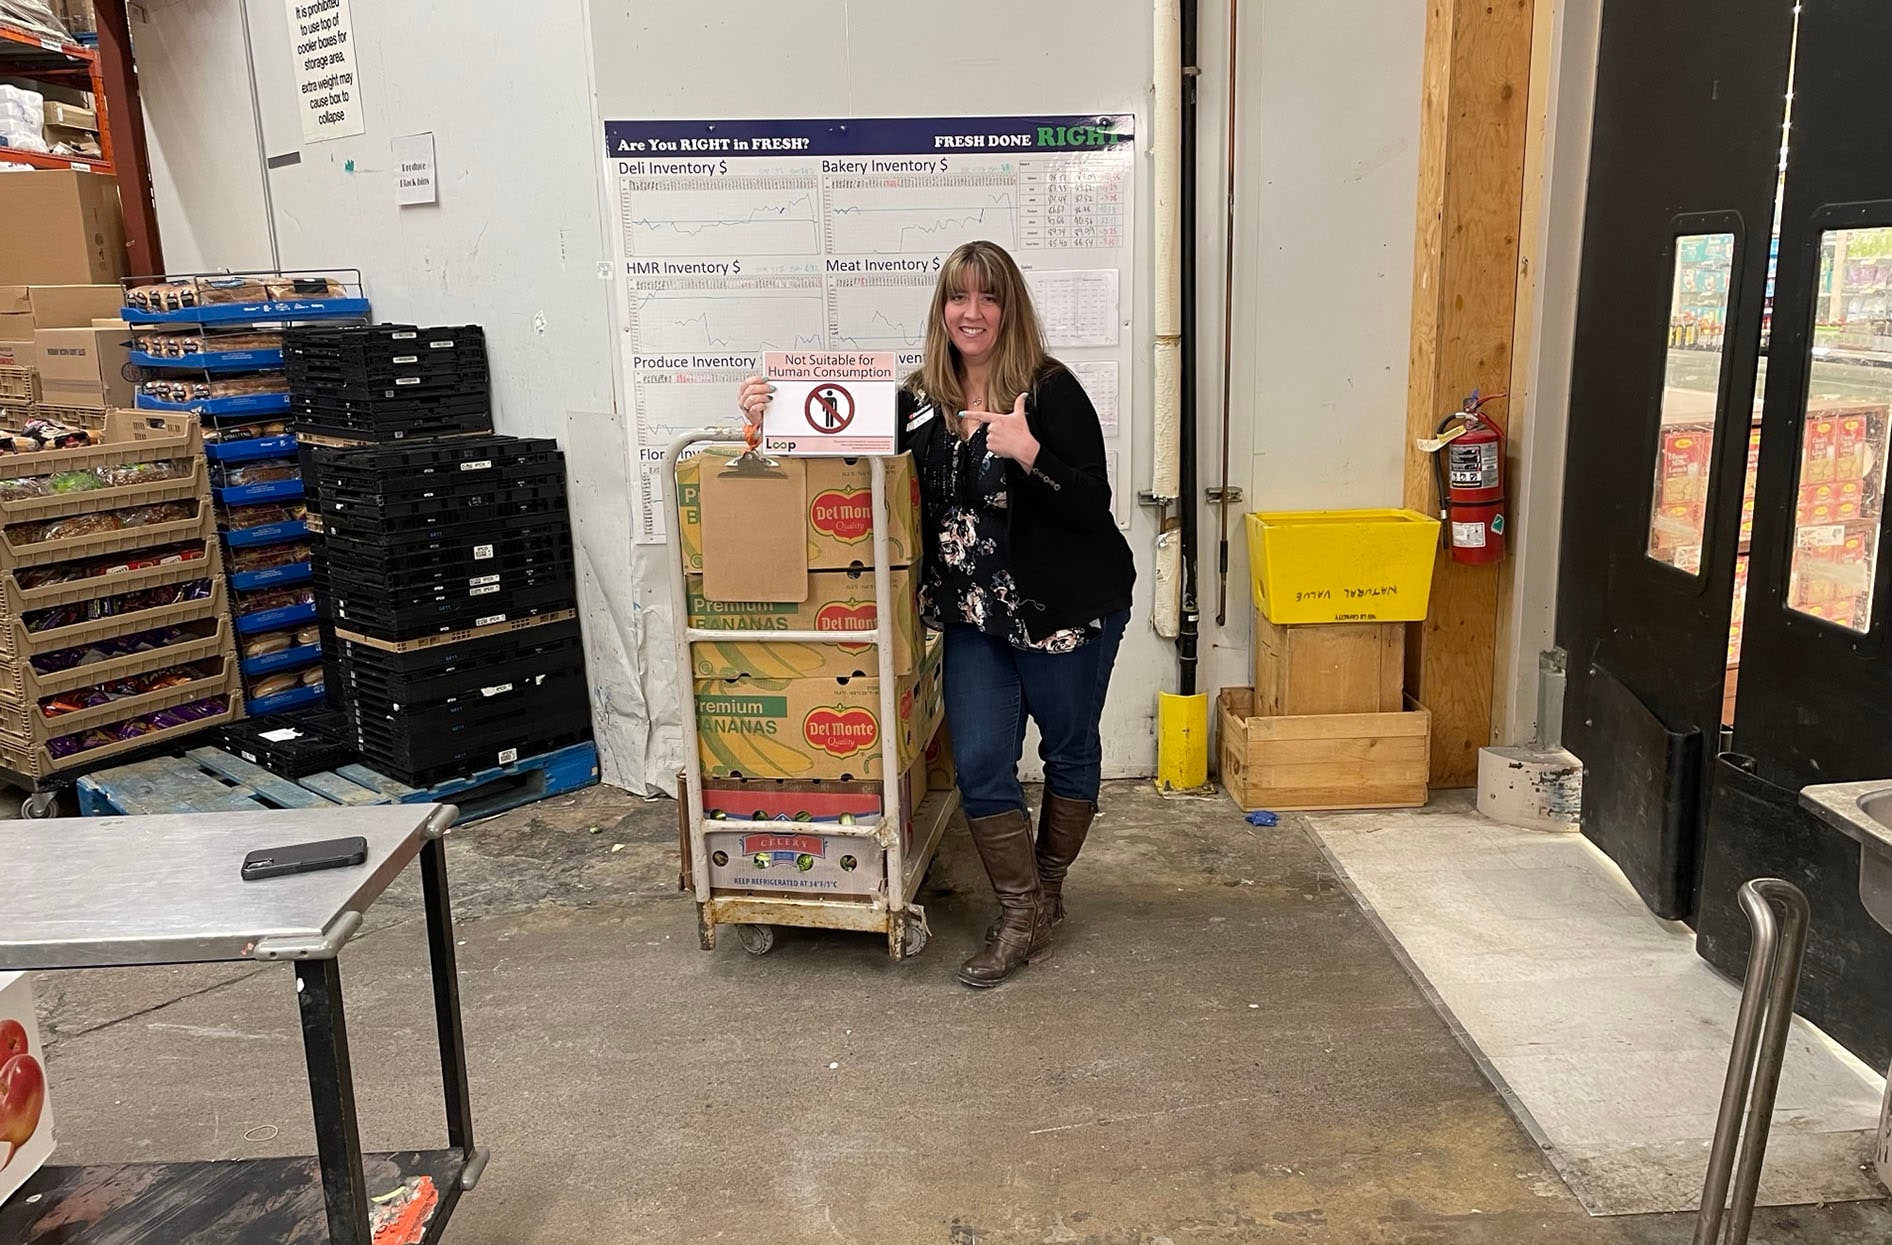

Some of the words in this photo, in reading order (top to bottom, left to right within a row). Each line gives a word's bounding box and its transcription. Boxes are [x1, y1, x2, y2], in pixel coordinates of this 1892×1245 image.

[295, 6, 301, 20] It
[301, 5, 308, 18] is
[308, 0, 340, 19] prohibited
[300, 24, 308, 36] to
[308, 21, 320, 34] use
[320, 18, 332, 31] top
[333, 12, 340, 26] of
[297, 39, 317, 55] cooler
[318, 34, 338, 50] boxes
[338, 30, 347, 43] for
[304, 55, 329, 71] storage
[301, 80, 317, 94] extra
[318, 73, 339, 90] weight
[339, 72, 353, 86] may
[309, 96, 329, 109] cause
[328, 92, 341, 106] box
[341, 90, 350, 103] to
[318, 110, 345, 125] collapse
[618, 139, 645, 151] Are
[649, 139, 677, 151] You
[680, 138, 730, 151] RIGHT
[734, 138, 749, 150] in
[752, 138, 810, 150] FRESH?
[934, 135, 985, 148] FRESH
[988, 134, 1031, 147] DONE
[619, 162, 645, 175] Deli
[649, 162, 715, 177] Inventory
[719, 160, 728, 175] $
[822, 160, 868, 175] Bakery
[871, 159, 936, 174] Inventory
[940, 157, 948, 173] $
[626, 262, 660, 275] HMR
[664, 261, 728, 277] Inventory
[732, 259, 741, 275] $
[826, 258, 861, 273] Meat
[865, 259, 929, 274] Inventory
[932, 257, 940, 272] $
[633, 356, 688, 369] Produce
[693, 355, 756, 371] Inventory
[785, 354, 806, 365] Not
[809, 354, 856, 366] Suitable
[859, 354, 875, 366] for
[768, 367, 810, 378] Human
[813, 366, 891, 379] Consumption
[766, 438, 796, 452] Loop
[640, 448, 665, 460] Flor
[816, 506, 838, 520] Del
[841, 505, 872, 519] Mon
[835, 521, 865, 532] Quality
[1296, 590, 1331, 602] VALUE
[1344, 584, 1397, 599] NATURAL
[821, 617, 841, 630] Del
[1335, 613, 1359, 621] CAPACITY
[699, 700, 763, 714] remium
[701, 719, 778, 735] ANANAS
[809, 723, 830, 736] Del
[832, 722, 874, 736] Monte
[827, 737, 855, 747] Quality
[760, 838, 808, 848] CELERY
[734, 877, 751, 885] KEEP
[751, 878, 799, 887] REFRIGERATED
